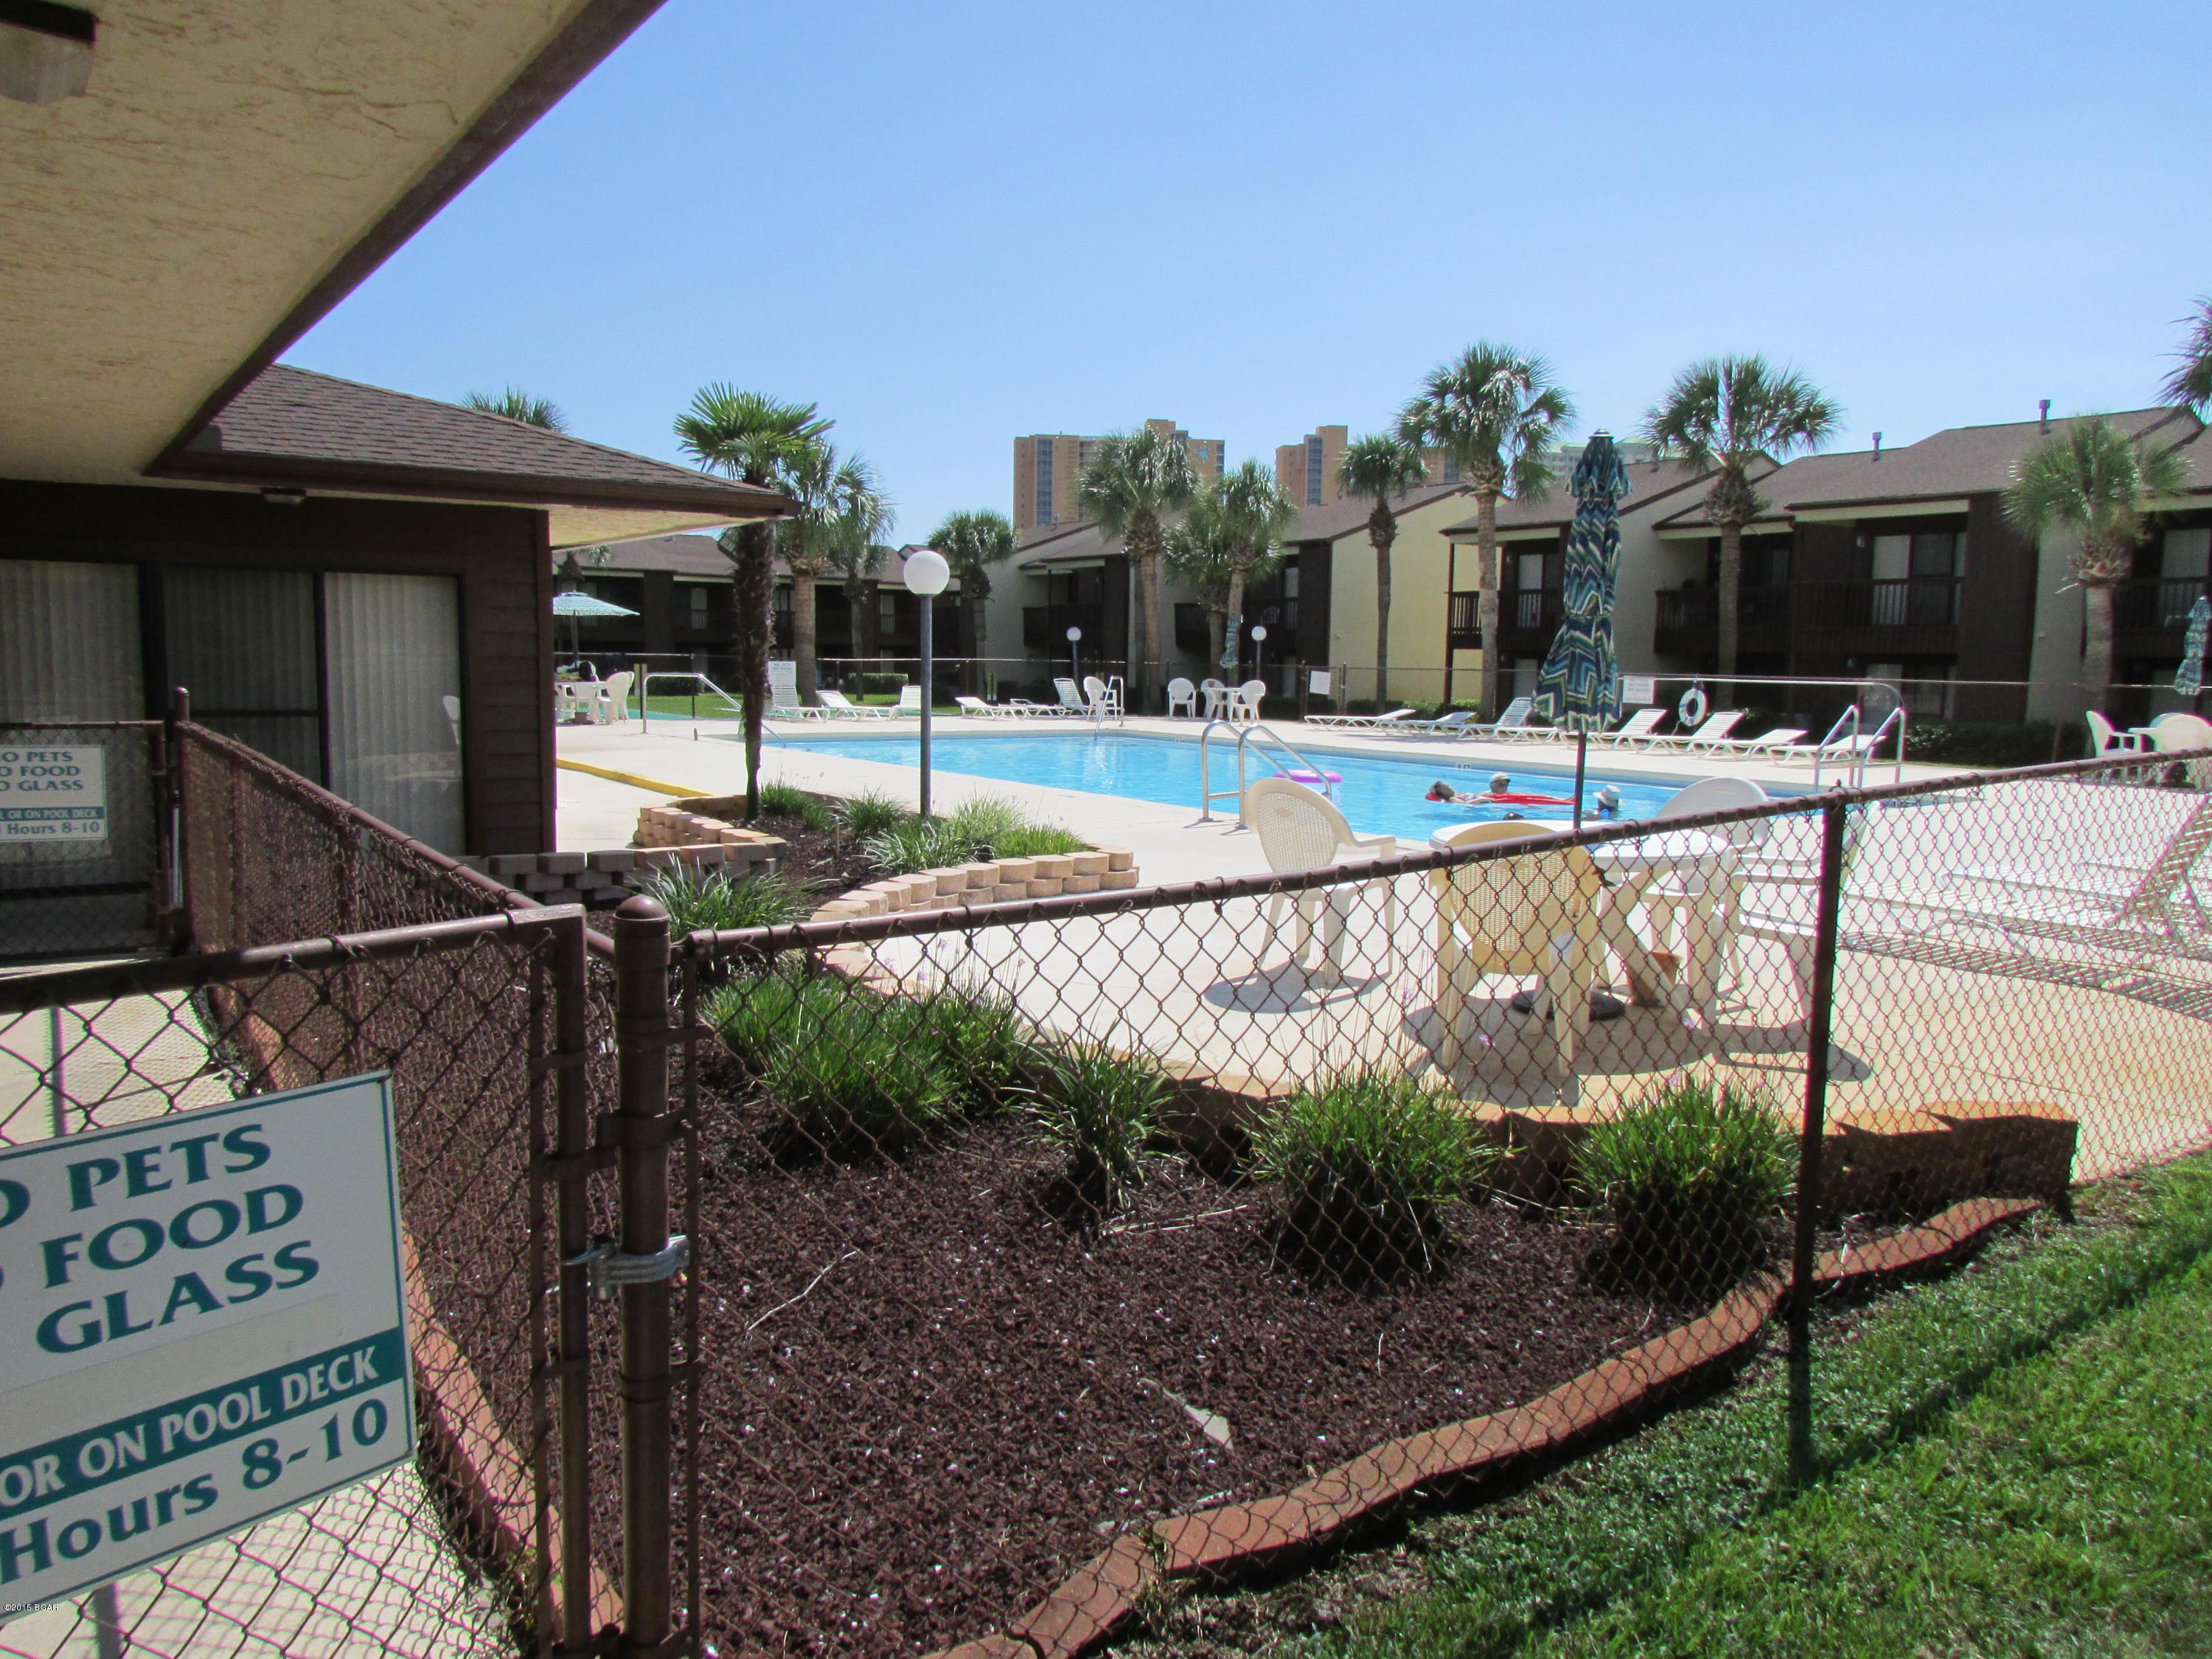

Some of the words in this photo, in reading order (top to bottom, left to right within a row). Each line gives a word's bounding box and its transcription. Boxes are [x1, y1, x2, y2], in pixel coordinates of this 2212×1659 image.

[0, 751, 19, 762] O
[27, 751, 72, 762] PETS
[0, 765, 13, 776] O
[21, 765, 80, 776] FOOD
[18, 779, 83, 791] GLASS
[7, 823, 56, 835] Hours
[61, 821, 100, 834] 8-10
[73, 809, 97, 818] DECK
[66, 1123, 271, 1212] PETS
[41, 1183, 304, 1289] FOOD
[36, 1239, 320, 1354] GLASS
[79, 1424, 147, 1479] ON
[160, 1387, 271, 1455] POOL
[282, 1346, 379, 1407] DECK
[0, 1472, 219, 1582] Hours
[241, 1399, 388, 1492] 8-10
